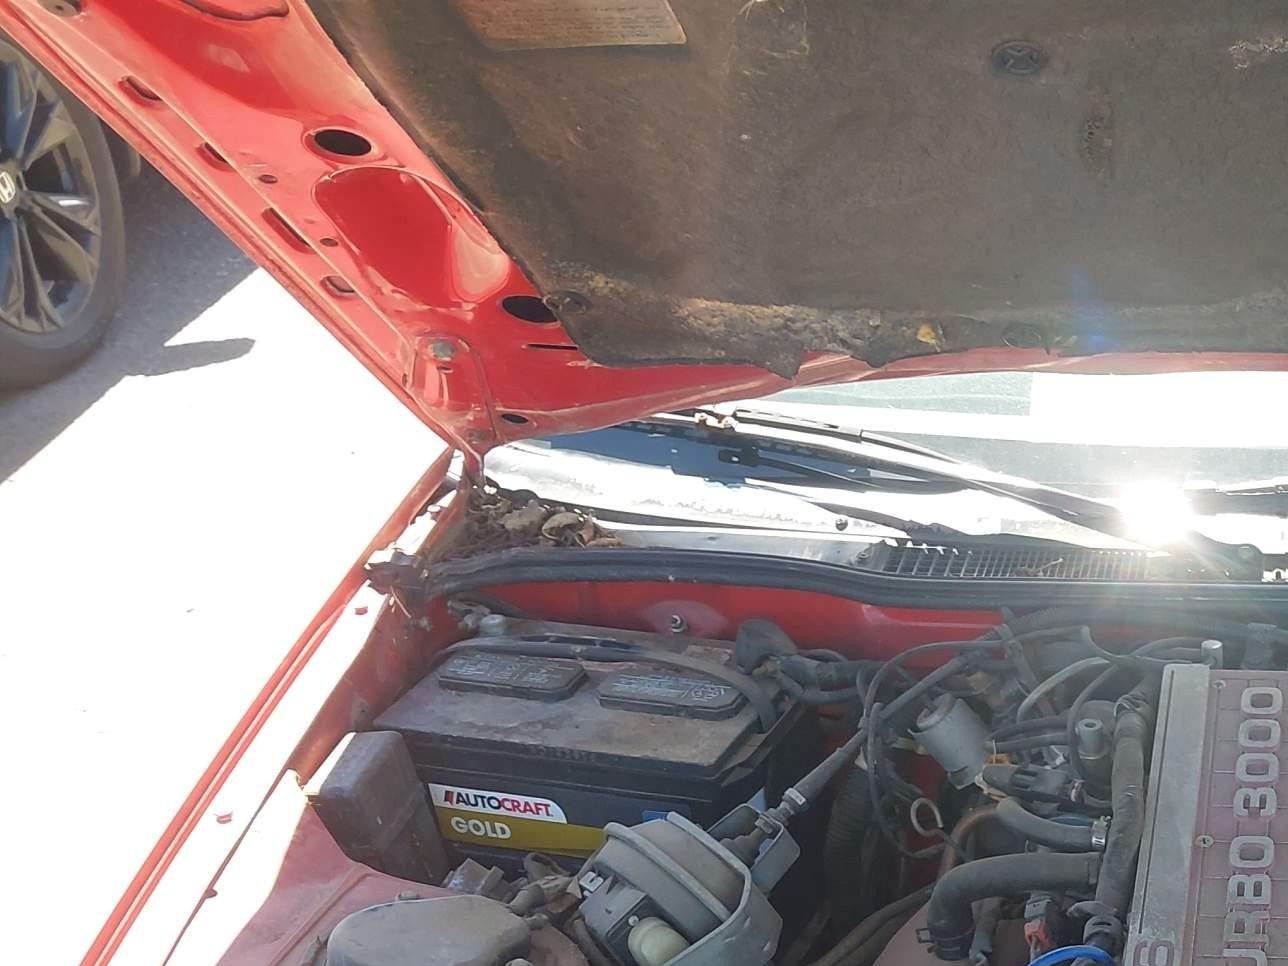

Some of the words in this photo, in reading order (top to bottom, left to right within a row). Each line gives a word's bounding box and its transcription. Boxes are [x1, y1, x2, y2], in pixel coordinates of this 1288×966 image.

[1233, 686, 1283, 818] 3000
[454, 791, 553, 817] AUTOCRAFT
[450, 817, 512, 839] GOLD
